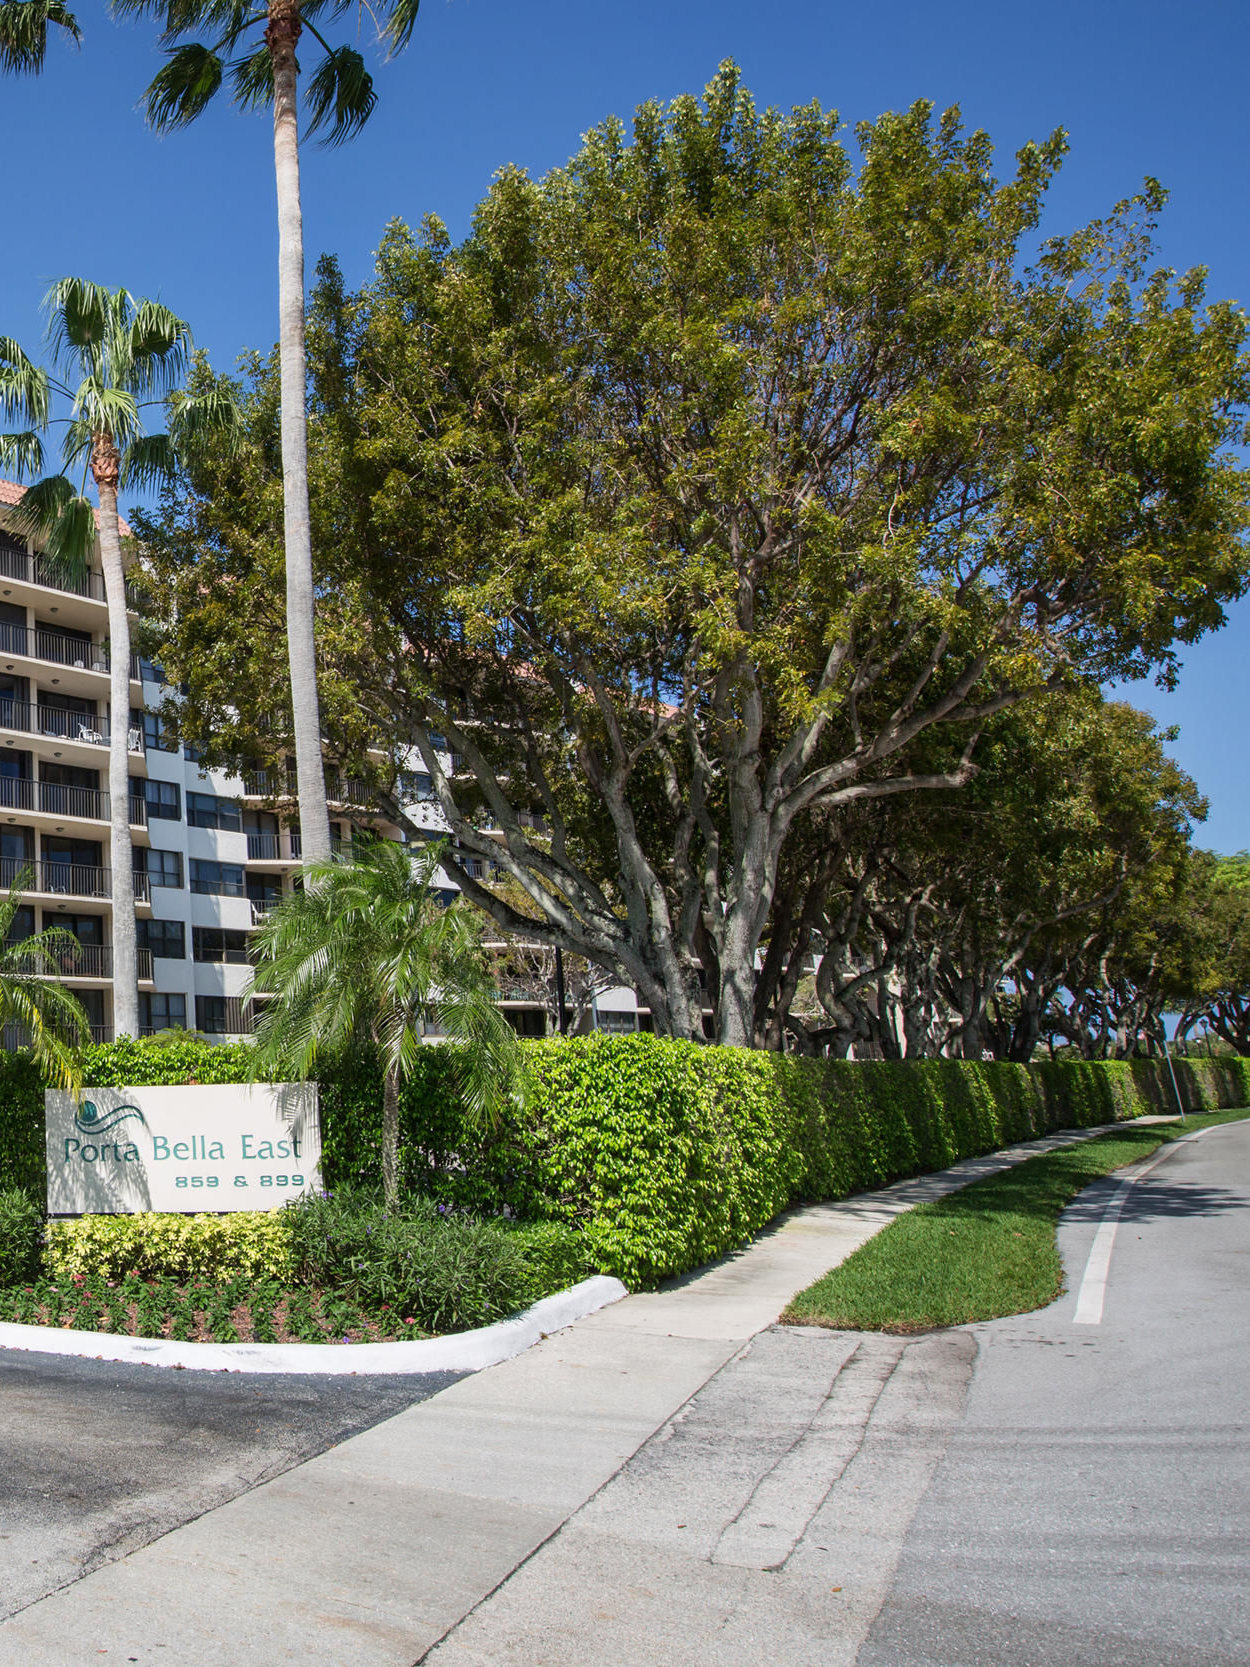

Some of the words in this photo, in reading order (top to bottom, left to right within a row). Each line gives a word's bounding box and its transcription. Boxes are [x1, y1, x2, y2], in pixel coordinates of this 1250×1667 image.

[64, 1138, 140, 1163] Porta
[153, 1135, 225, 1161] Bella
[241, 1134, 303, 1160] East
[175, 1176, 219, 1188] 859
[233, 1175, 249, 1187] &
[260, 1174, 305, 1187] 899
